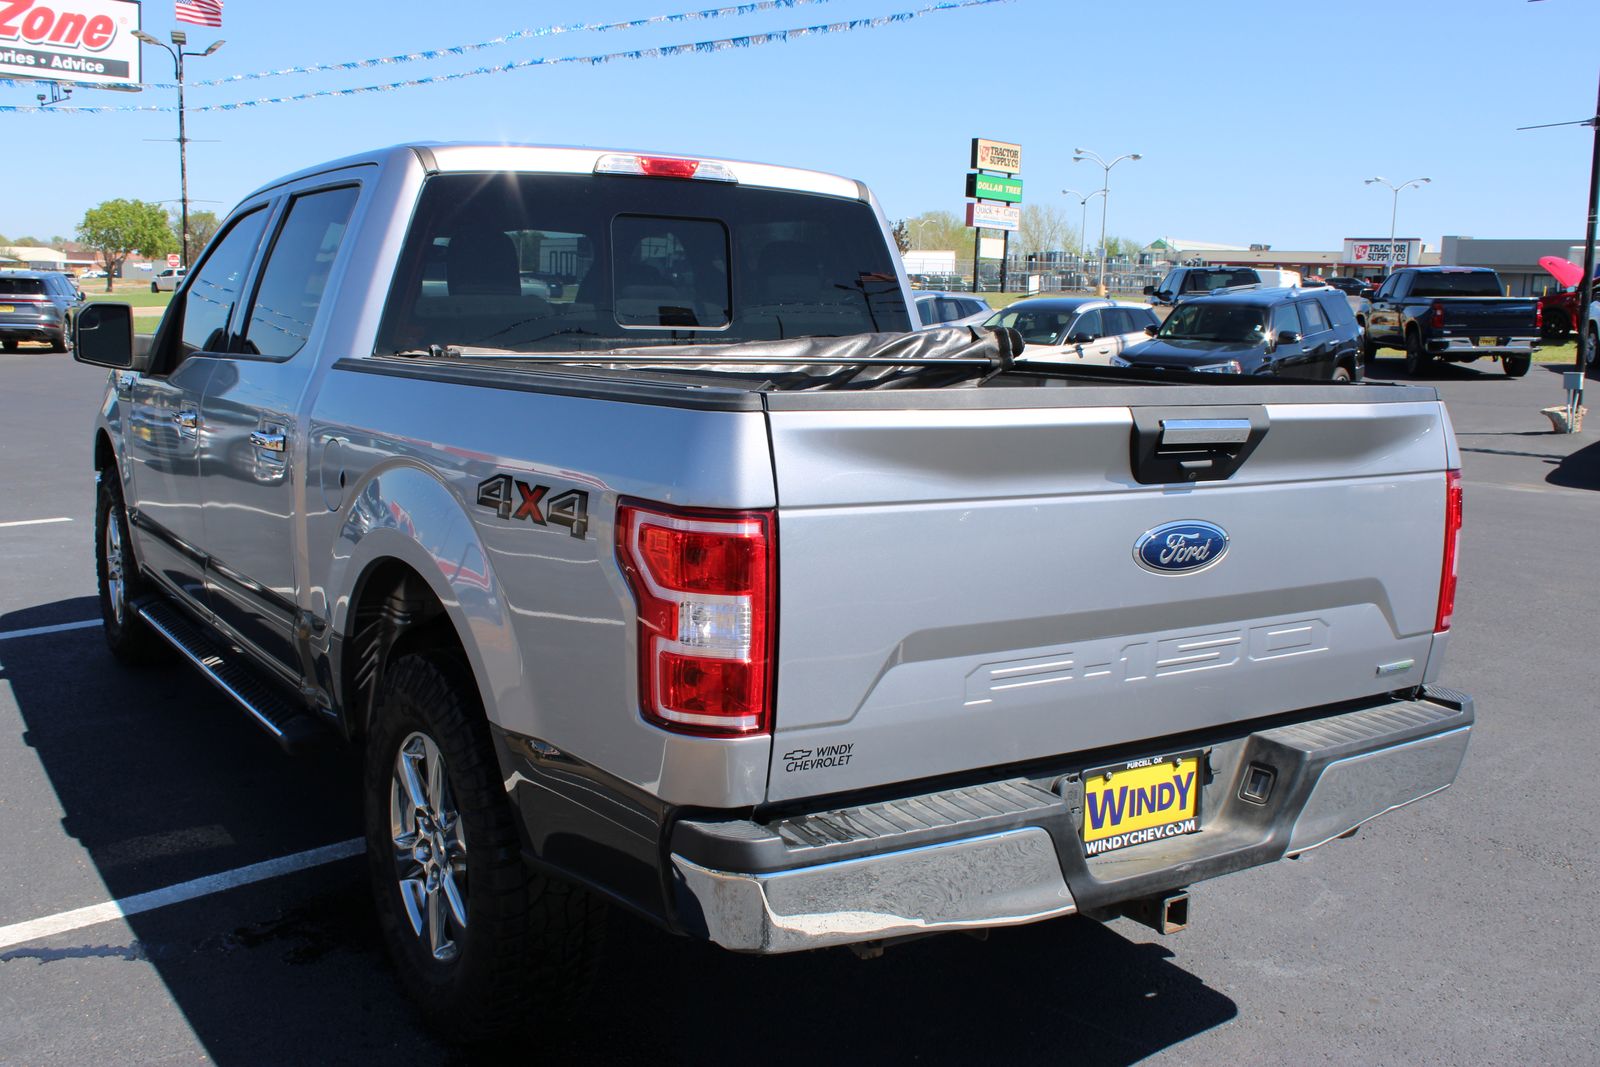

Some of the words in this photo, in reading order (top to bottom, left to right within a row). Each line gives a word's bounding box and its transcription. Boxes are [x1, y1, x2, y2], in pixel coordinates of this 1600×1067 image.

[51, 55, 105, 73] Advice
[990, 146, 1019, 159] TRACTOR
[990, 156, 1011, 167] SUPPLY
[977, 181, 1003, 193] DOLLAR
[1005, 185, 1021, 195] TREE
[975, 205, 993, 215] Quick
[1003, 208, 1018, 218] Care
[1160, 532, 1211, 564] Ford
[963, 618, 1331, 706] F-150
[816, 743, 854, 757] WINDY
[785, 754, 852, 773] CHEVROLET
[1153, 756, 1163, 764] OK
[1086, 819, 1196, 855] WINDYCHEV.COM
